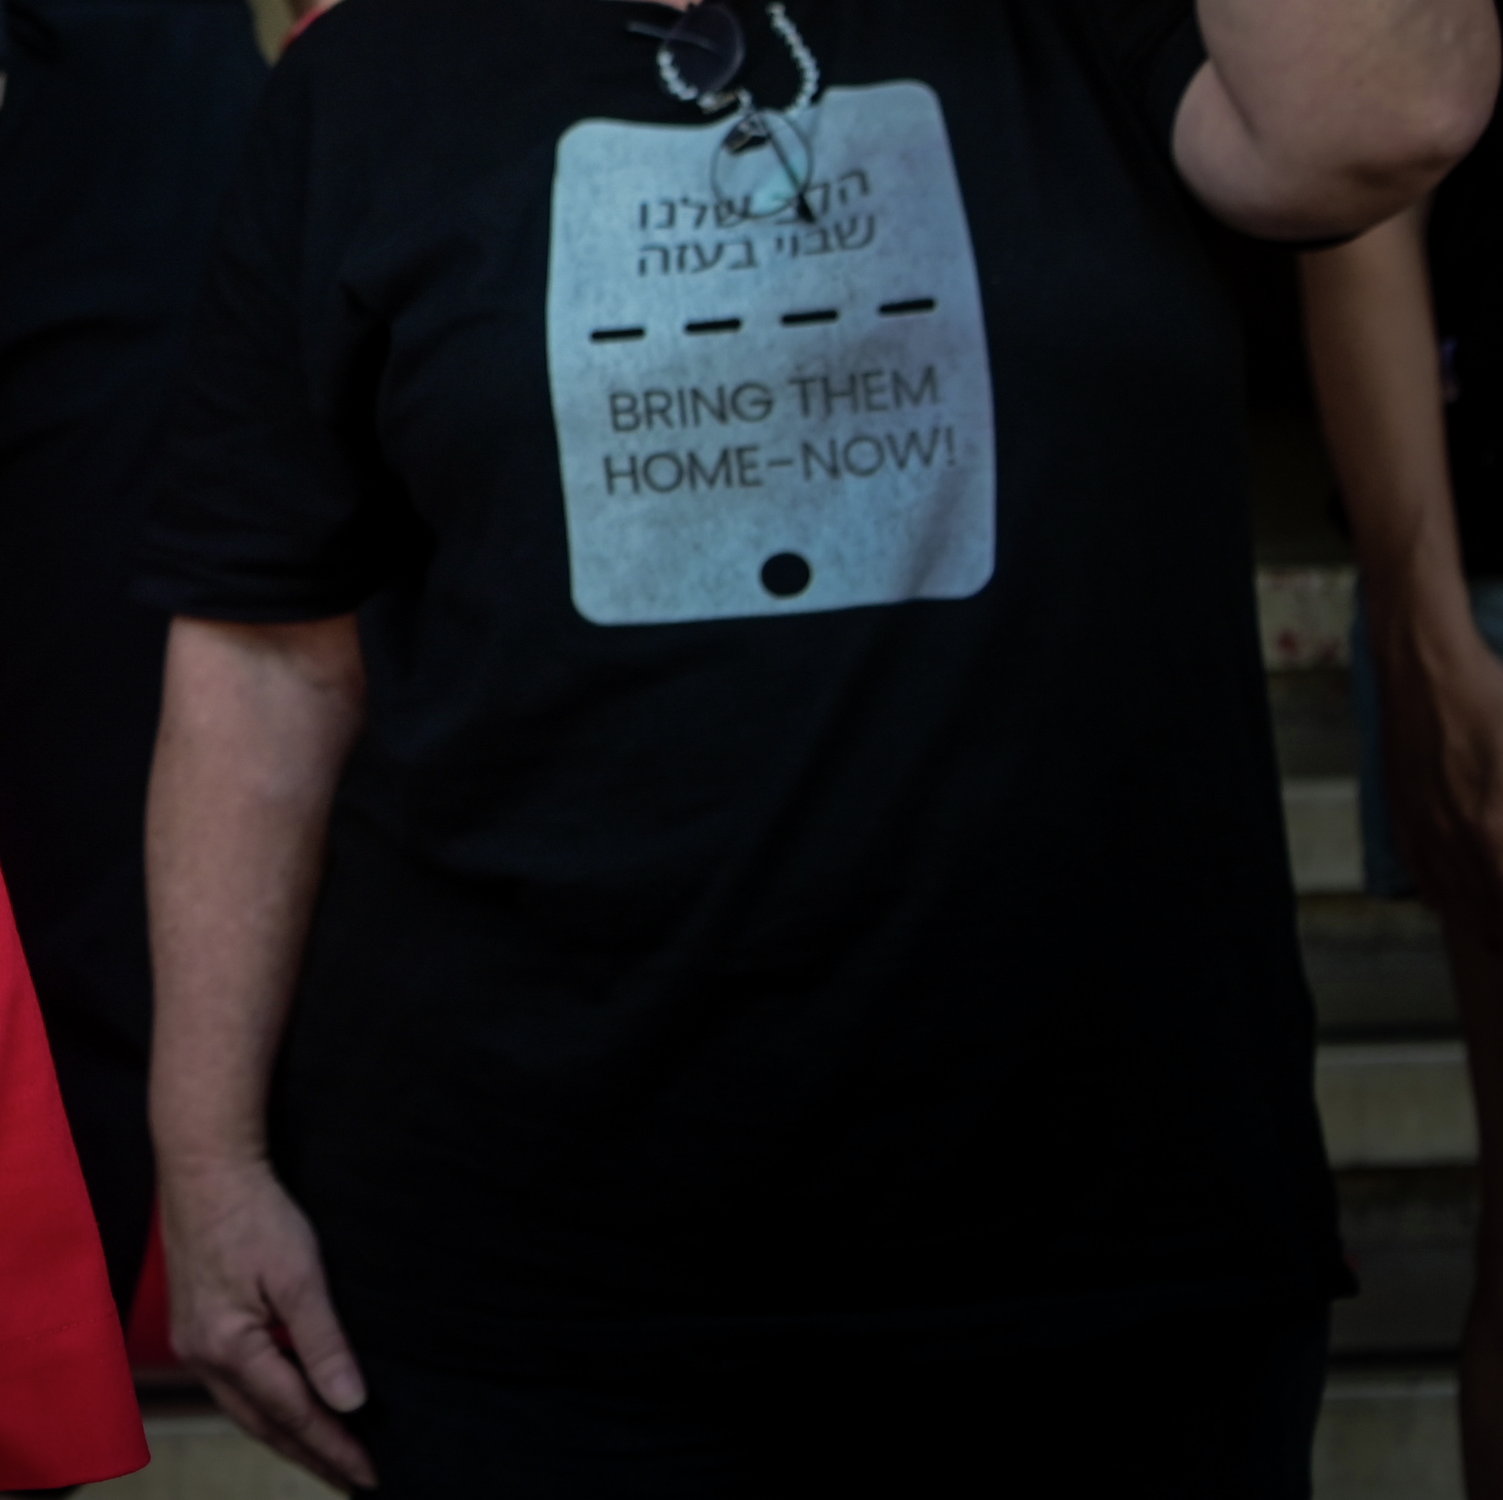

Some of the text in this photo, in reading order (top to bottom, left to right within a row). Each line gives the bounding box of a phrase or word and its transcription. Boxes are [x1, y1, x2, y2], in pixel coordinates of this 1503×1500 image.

[639, 193, 753, 230] שלנו
[638, 215, 876, 276] שבוי בעזה
[608, 365, 939, 433] BRING THEM
